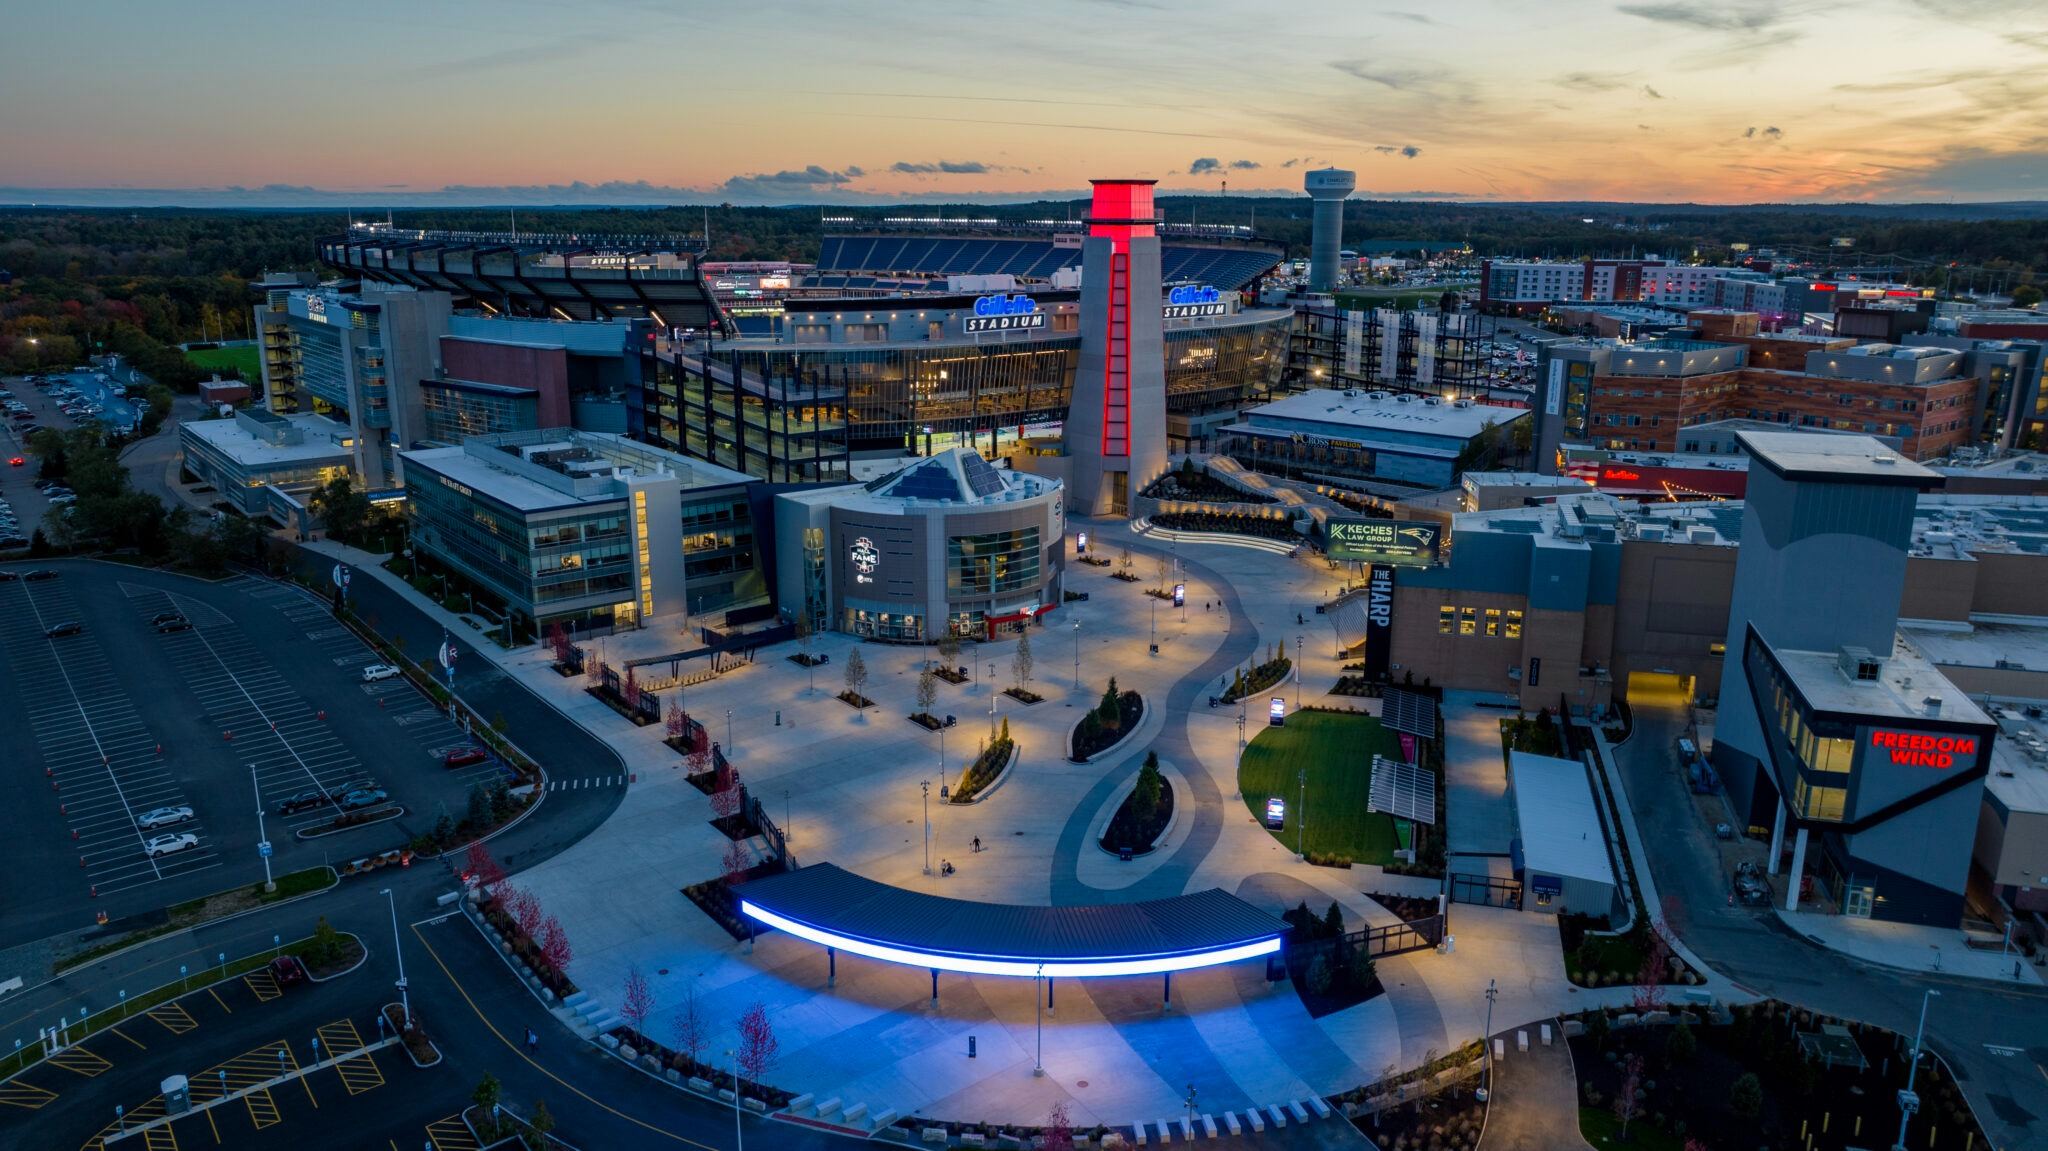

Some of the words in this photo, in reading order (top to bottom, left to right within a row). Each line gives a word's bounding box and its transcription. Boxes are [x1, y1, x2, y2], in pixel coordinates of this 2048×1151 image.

[1169, 285, 1220, 305] Gillette
[974, 294, 1037, 317] Gillette
[1164, 304, 1225, 318] STADIUM
[969, 316, 1042, 331] STADIUM
[1347, 524, 1393, 536] KECHES
[1366, 535, 1393, 543] GROUP
[851, 552, 877, 564] FAME
[1374, 569, 1390, 580] THE
[1370, 580, 1392, 627] HARP
[1872, 730, 1976, 754] FREEDOM
[1890, 749, 1953, 769] WIND
